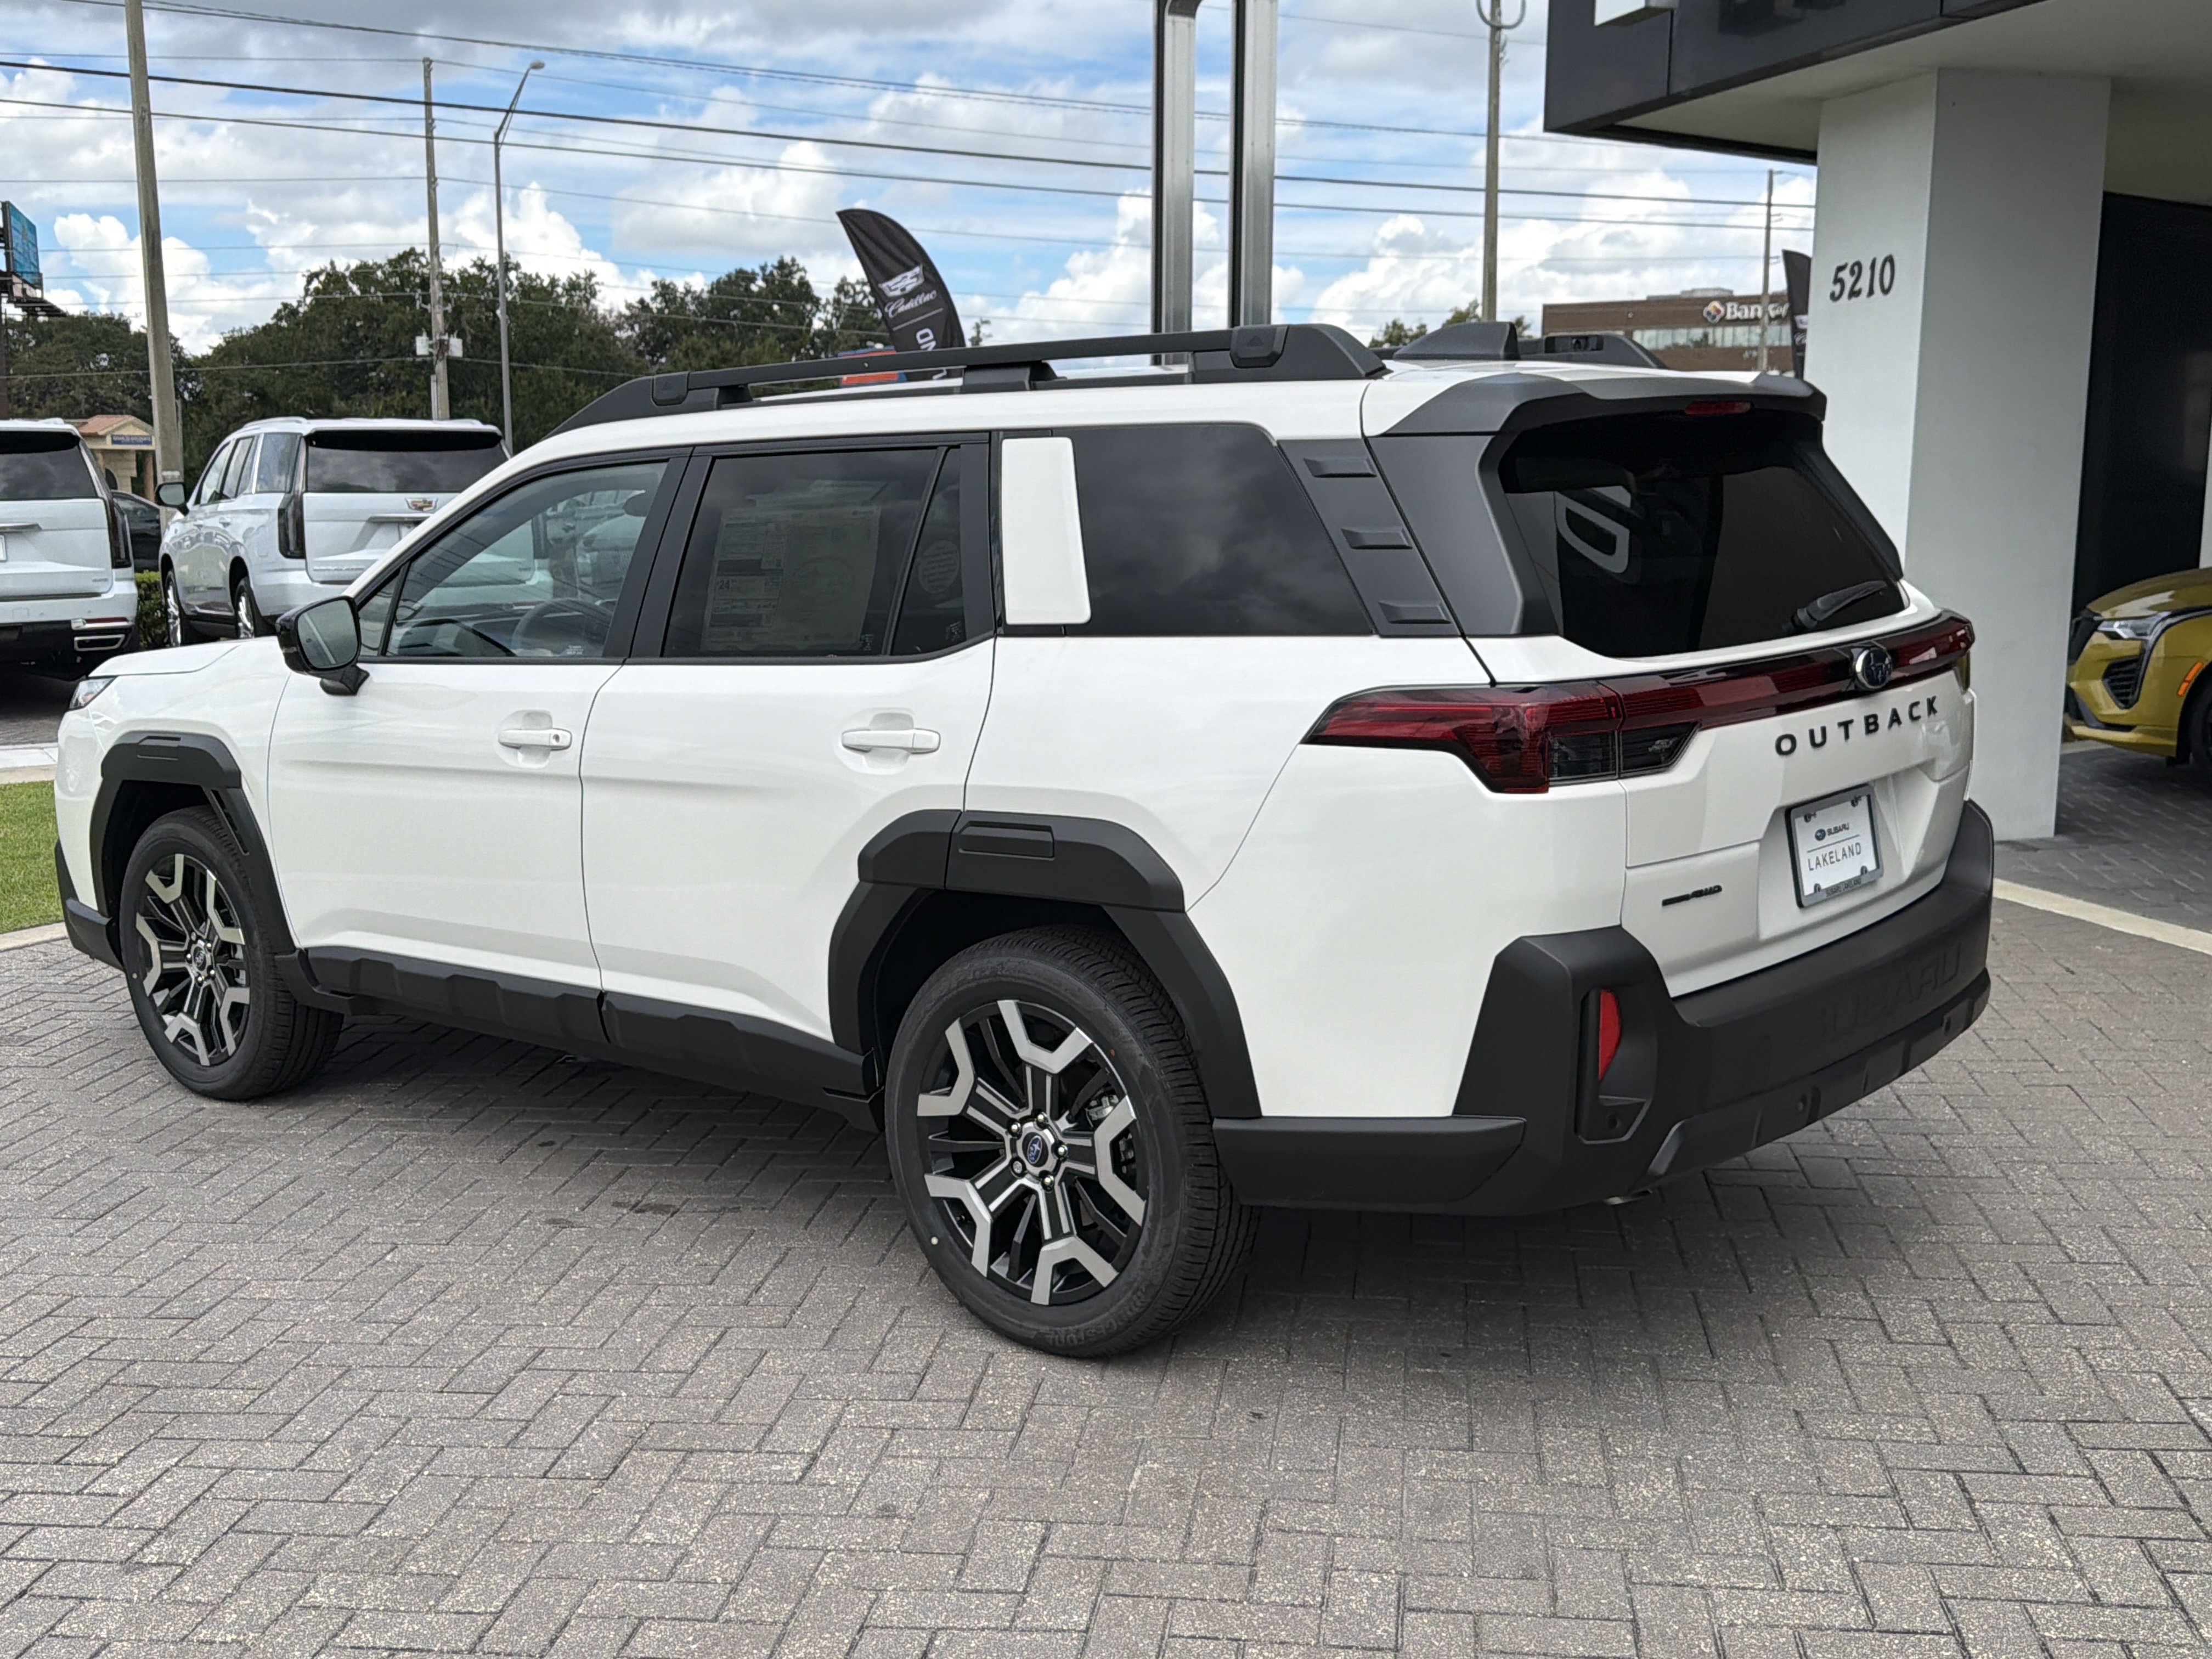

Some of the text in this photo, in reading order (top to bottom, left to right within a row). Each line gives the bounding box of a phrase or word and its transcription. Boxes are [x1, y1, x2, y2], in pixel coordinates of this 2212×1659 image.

[1830, 253, 1895, 302] 5210
[884, 290, 938, 318] Cadillac
[1775, 696, 1939, 756] OUTBACK
[1807, 842, 1862, 871] LAKELAND
